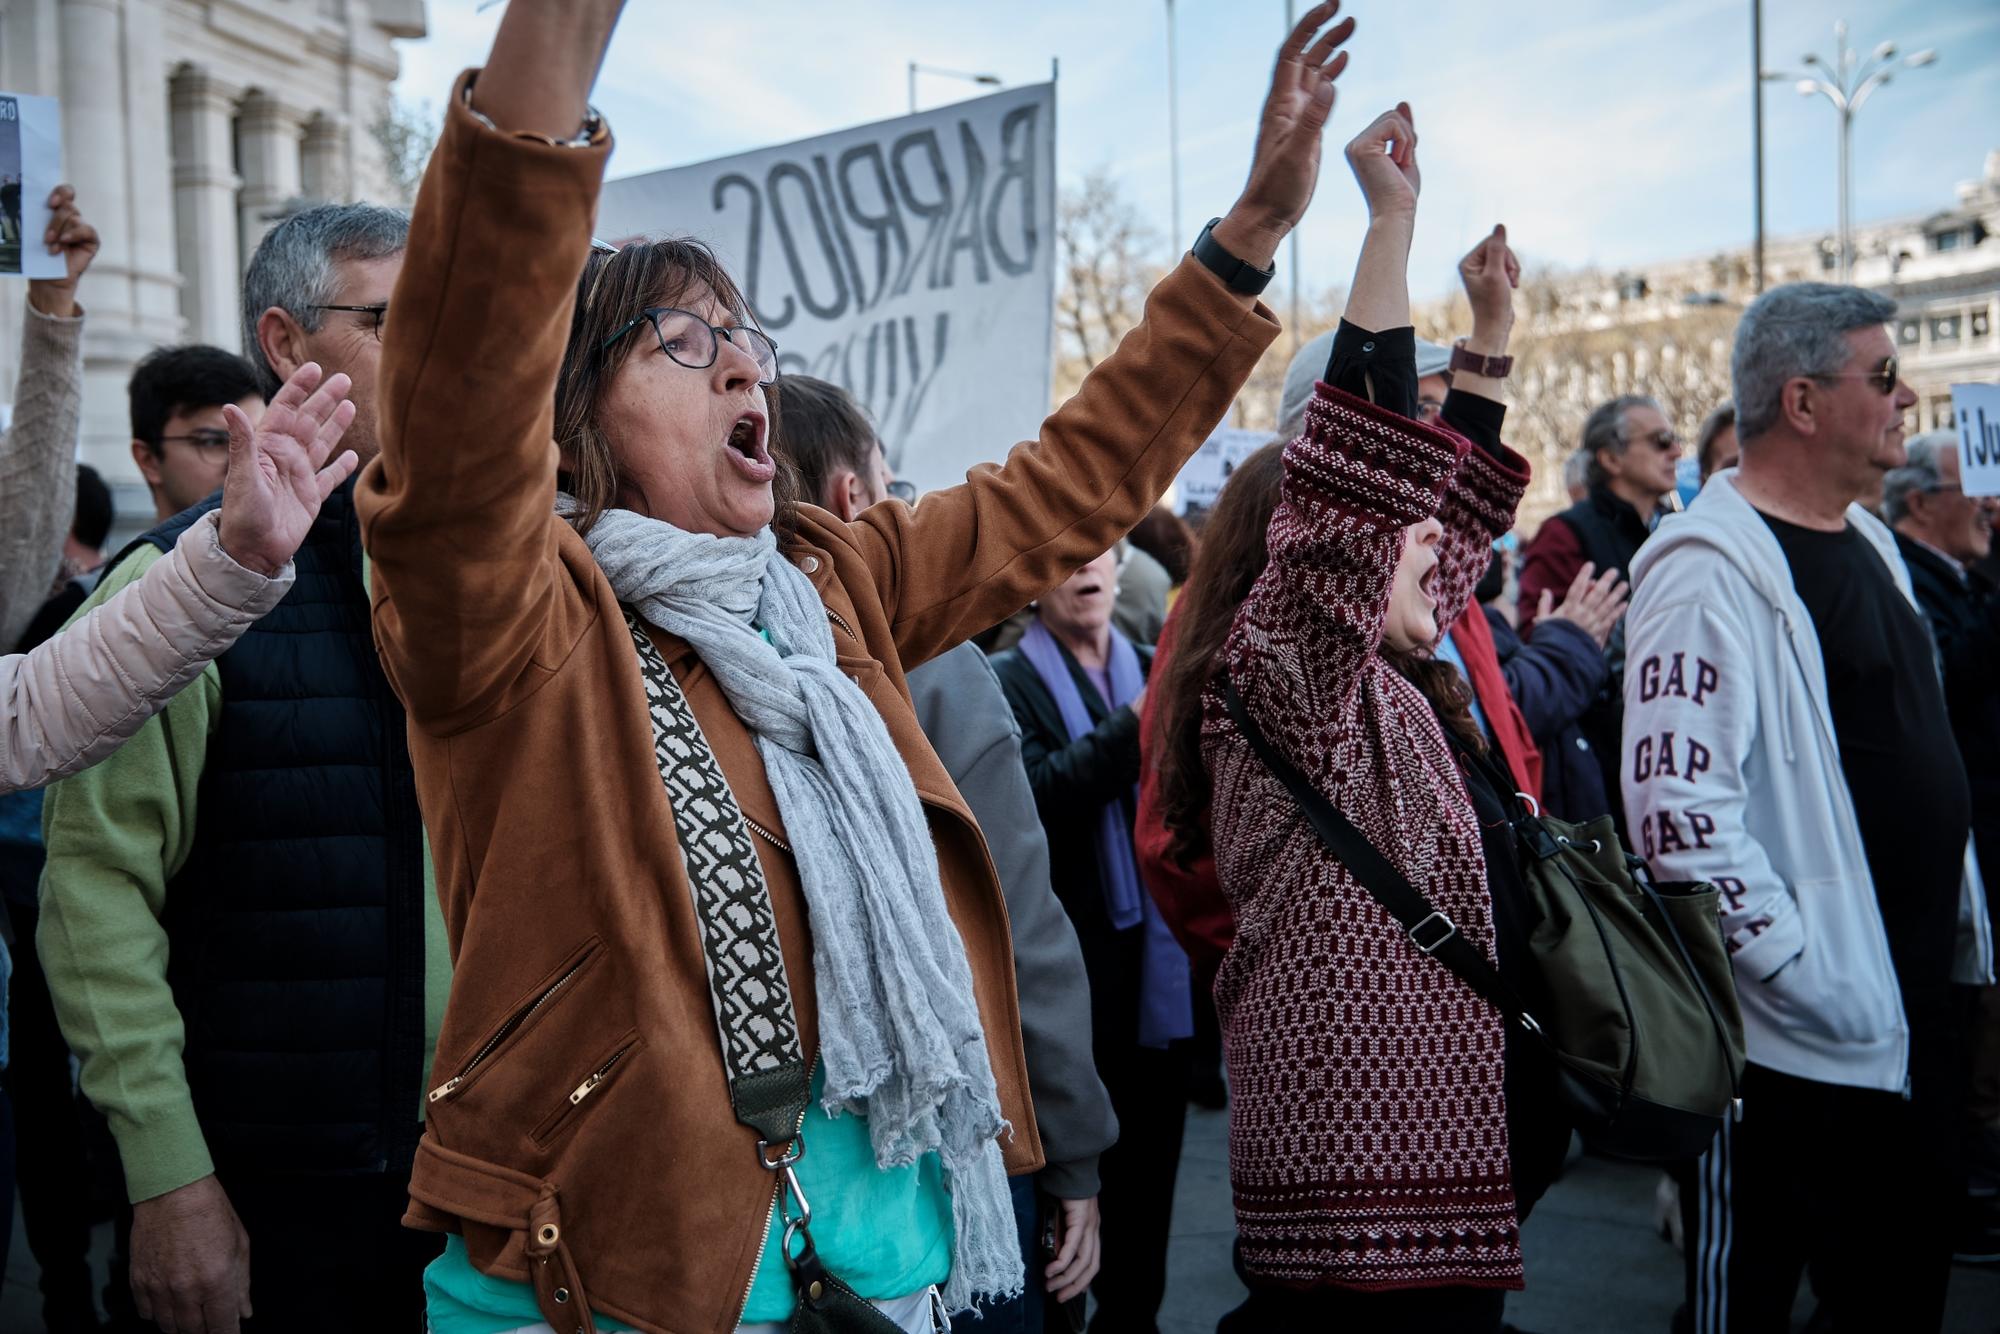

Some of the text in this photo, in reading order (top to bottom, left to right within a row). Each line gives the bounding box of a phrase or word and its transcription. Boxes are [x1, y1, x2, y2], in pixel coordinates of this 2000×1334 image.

[1639, 652, 1718, 706] GAP
[1633, 732, 1710, 783] GAP
[1641, 810, 1715, 862] GAP
